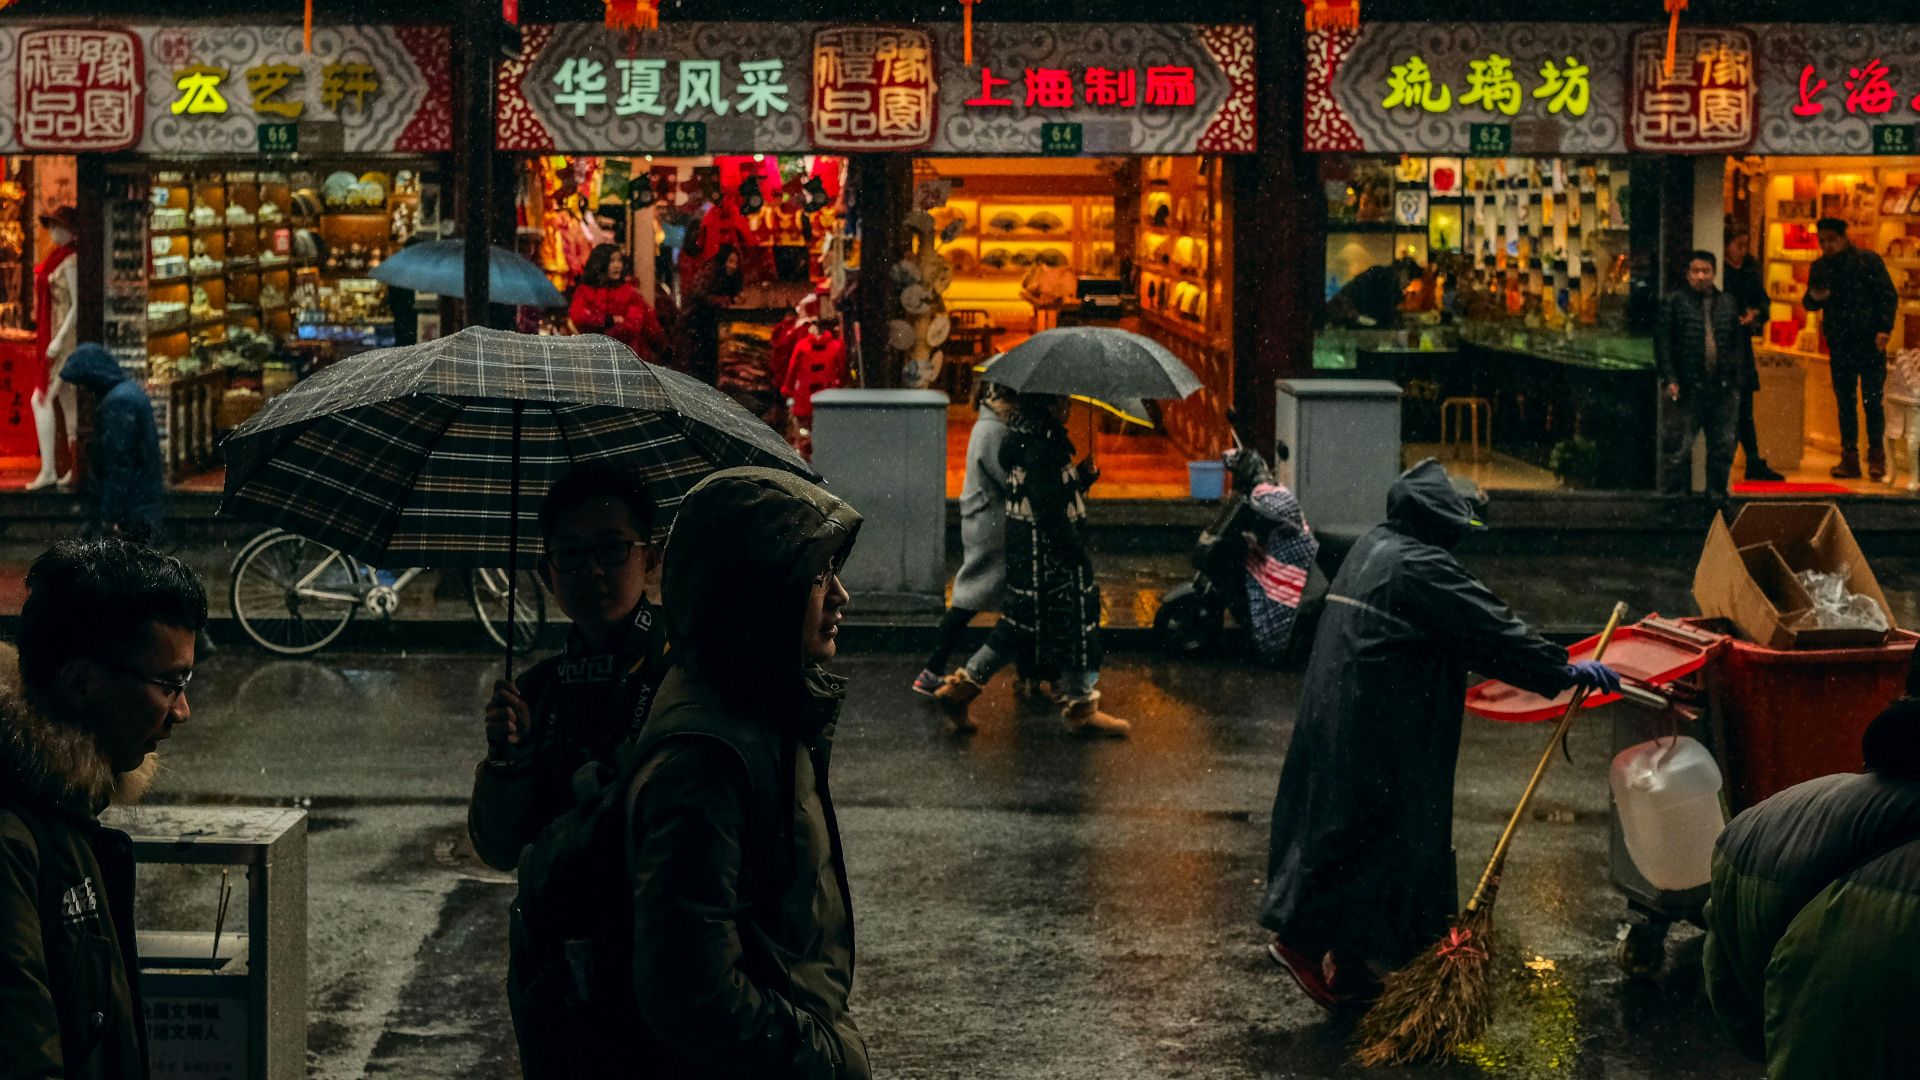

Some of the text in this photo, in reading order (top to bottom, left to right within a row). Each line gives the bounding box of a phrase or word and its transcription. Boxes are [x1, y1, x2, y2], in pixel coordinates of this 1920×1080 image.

[553, 58, 789, 117] 华夏风采
[964, 65, 1196, 108] 上海制扇
[1382, 54, 1590, 116] 琉璃坊
[1792, 58, 1920, 116] 上海
[267, 126, 288, 142] 66
[675, 125, 697, 141] 64
[1050, 125, 1072, 142] 64
[1479, 126, 1502, 143] 62
[1883, 127, 1904, 144] 62
[631, 683, 651, 729] SONY
